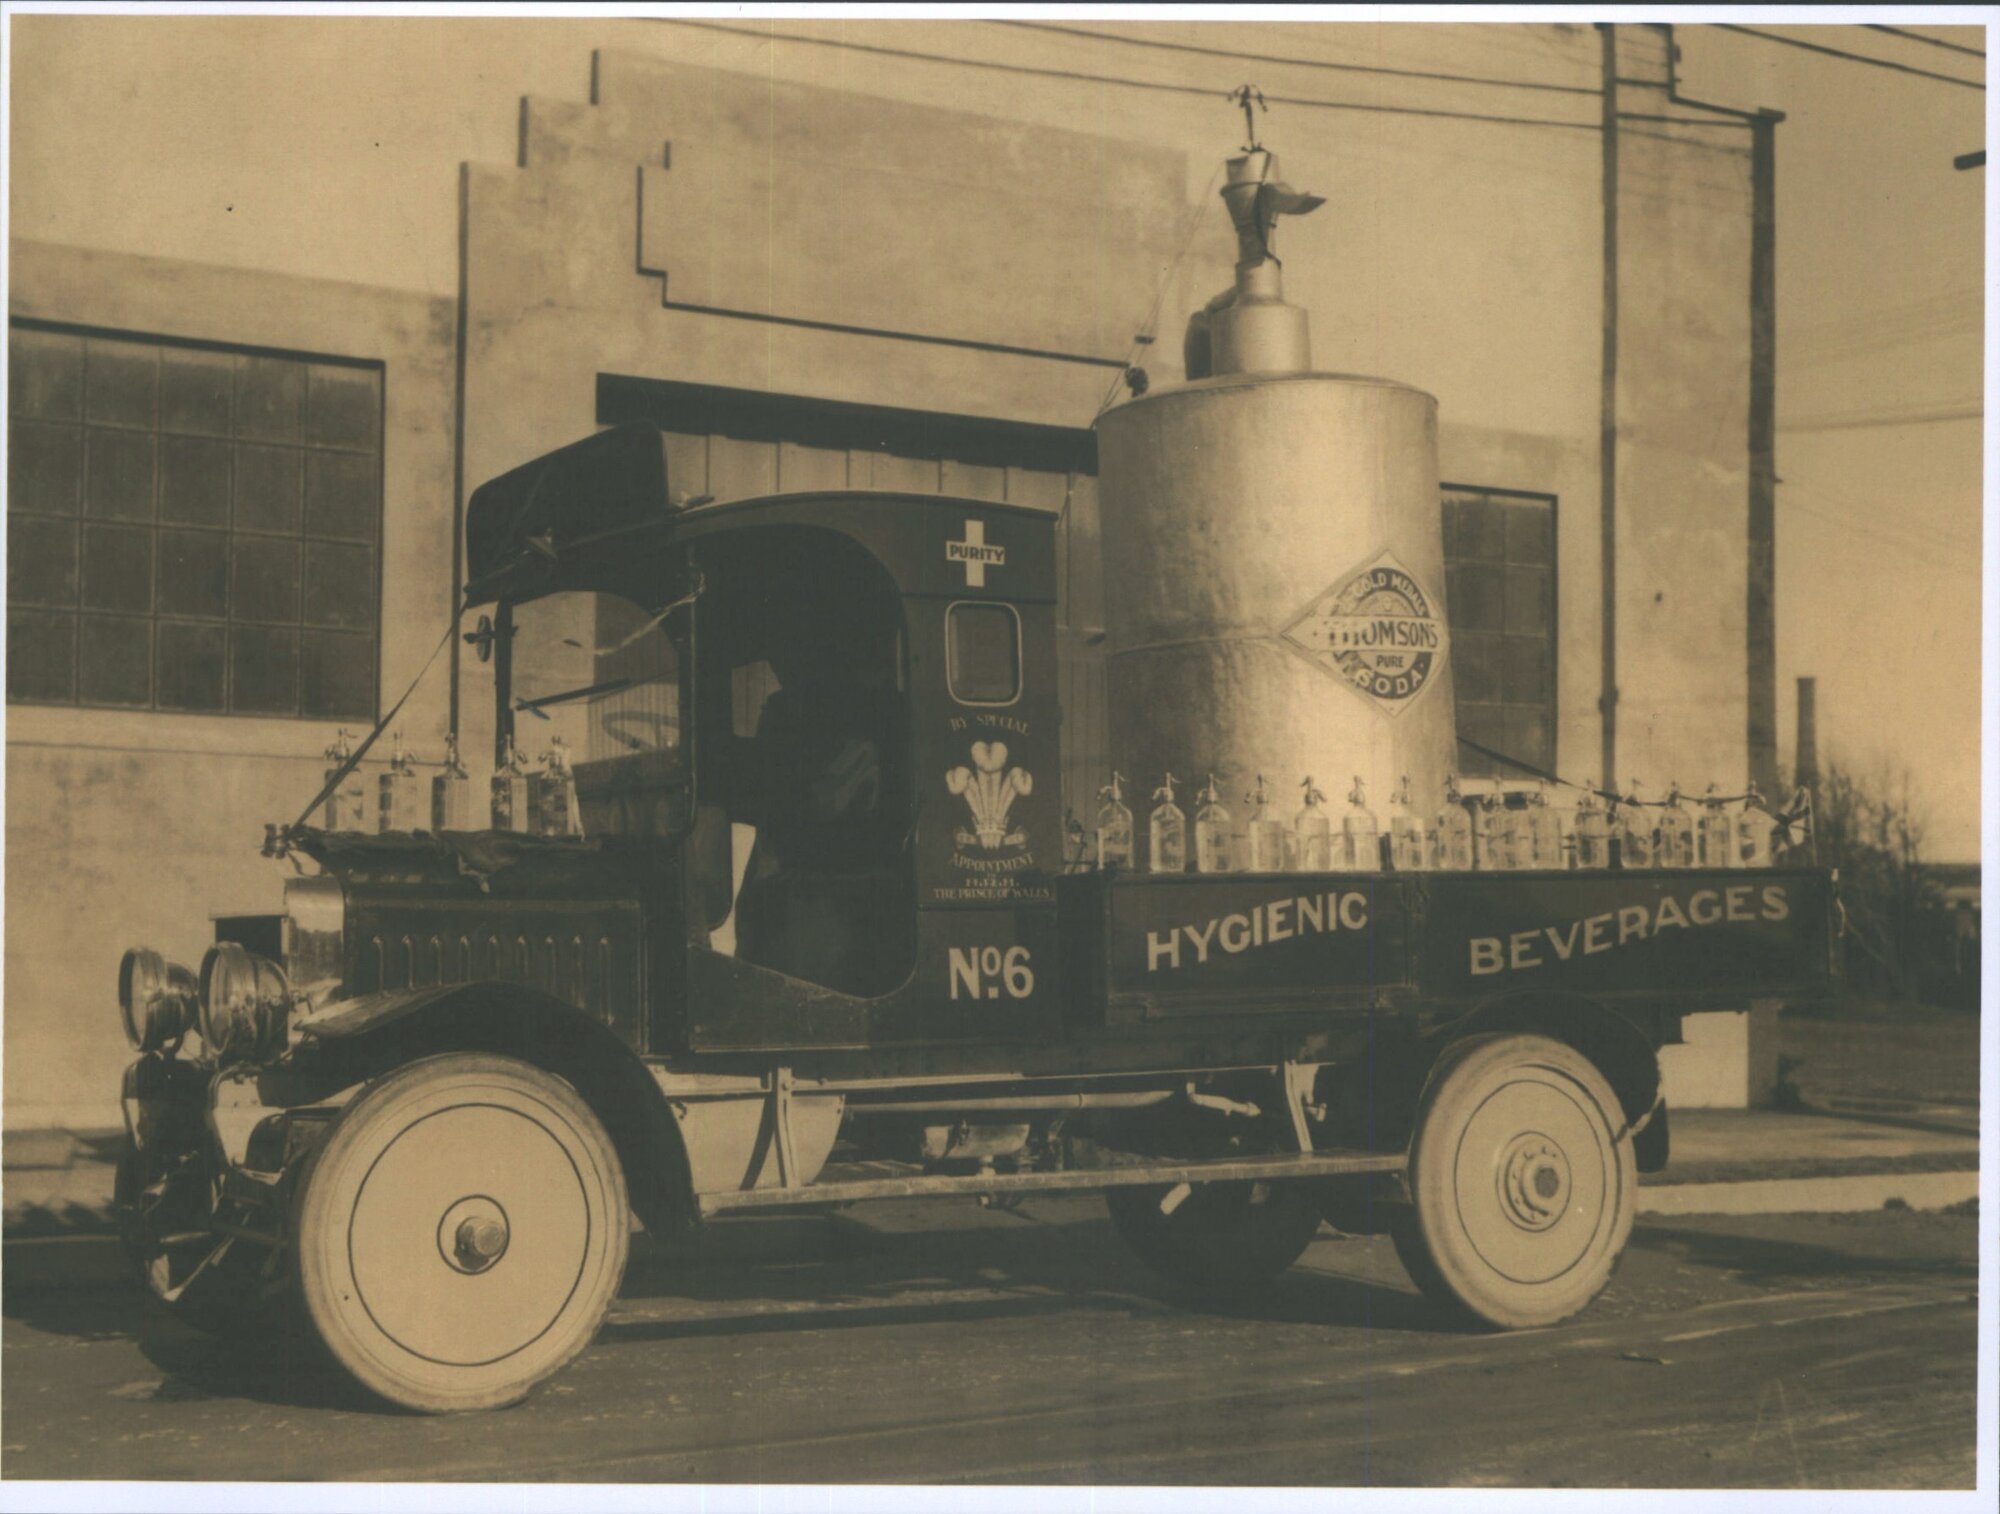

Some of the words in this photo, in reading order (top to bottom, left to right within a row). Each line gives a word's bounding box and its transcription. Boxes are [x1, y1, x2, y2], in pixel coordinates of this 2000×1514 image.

[948, 543, 1004, 562] PURITY
[1351, 572, 1388, 597] GOLD
[1391, 574, 1427, 616] MEDALS
[1376, 655, 1404, 667] PURE
[1354, 667, 1423, 695] SODA
[950, 716, 968, 731] BY
[976, 714, 1031, 736] SPECIAL
[948, 852, 1034, 872] APPOINTMENT
[933, 888, 956, 899] THE
[958, 887, 994, 899] PRINCE
[1011, 887, 1050, 898] WALES
[1147, 892, 1368, 972] HYGIENIC
[1469, 886, 1789, 975] BEVERAGES
